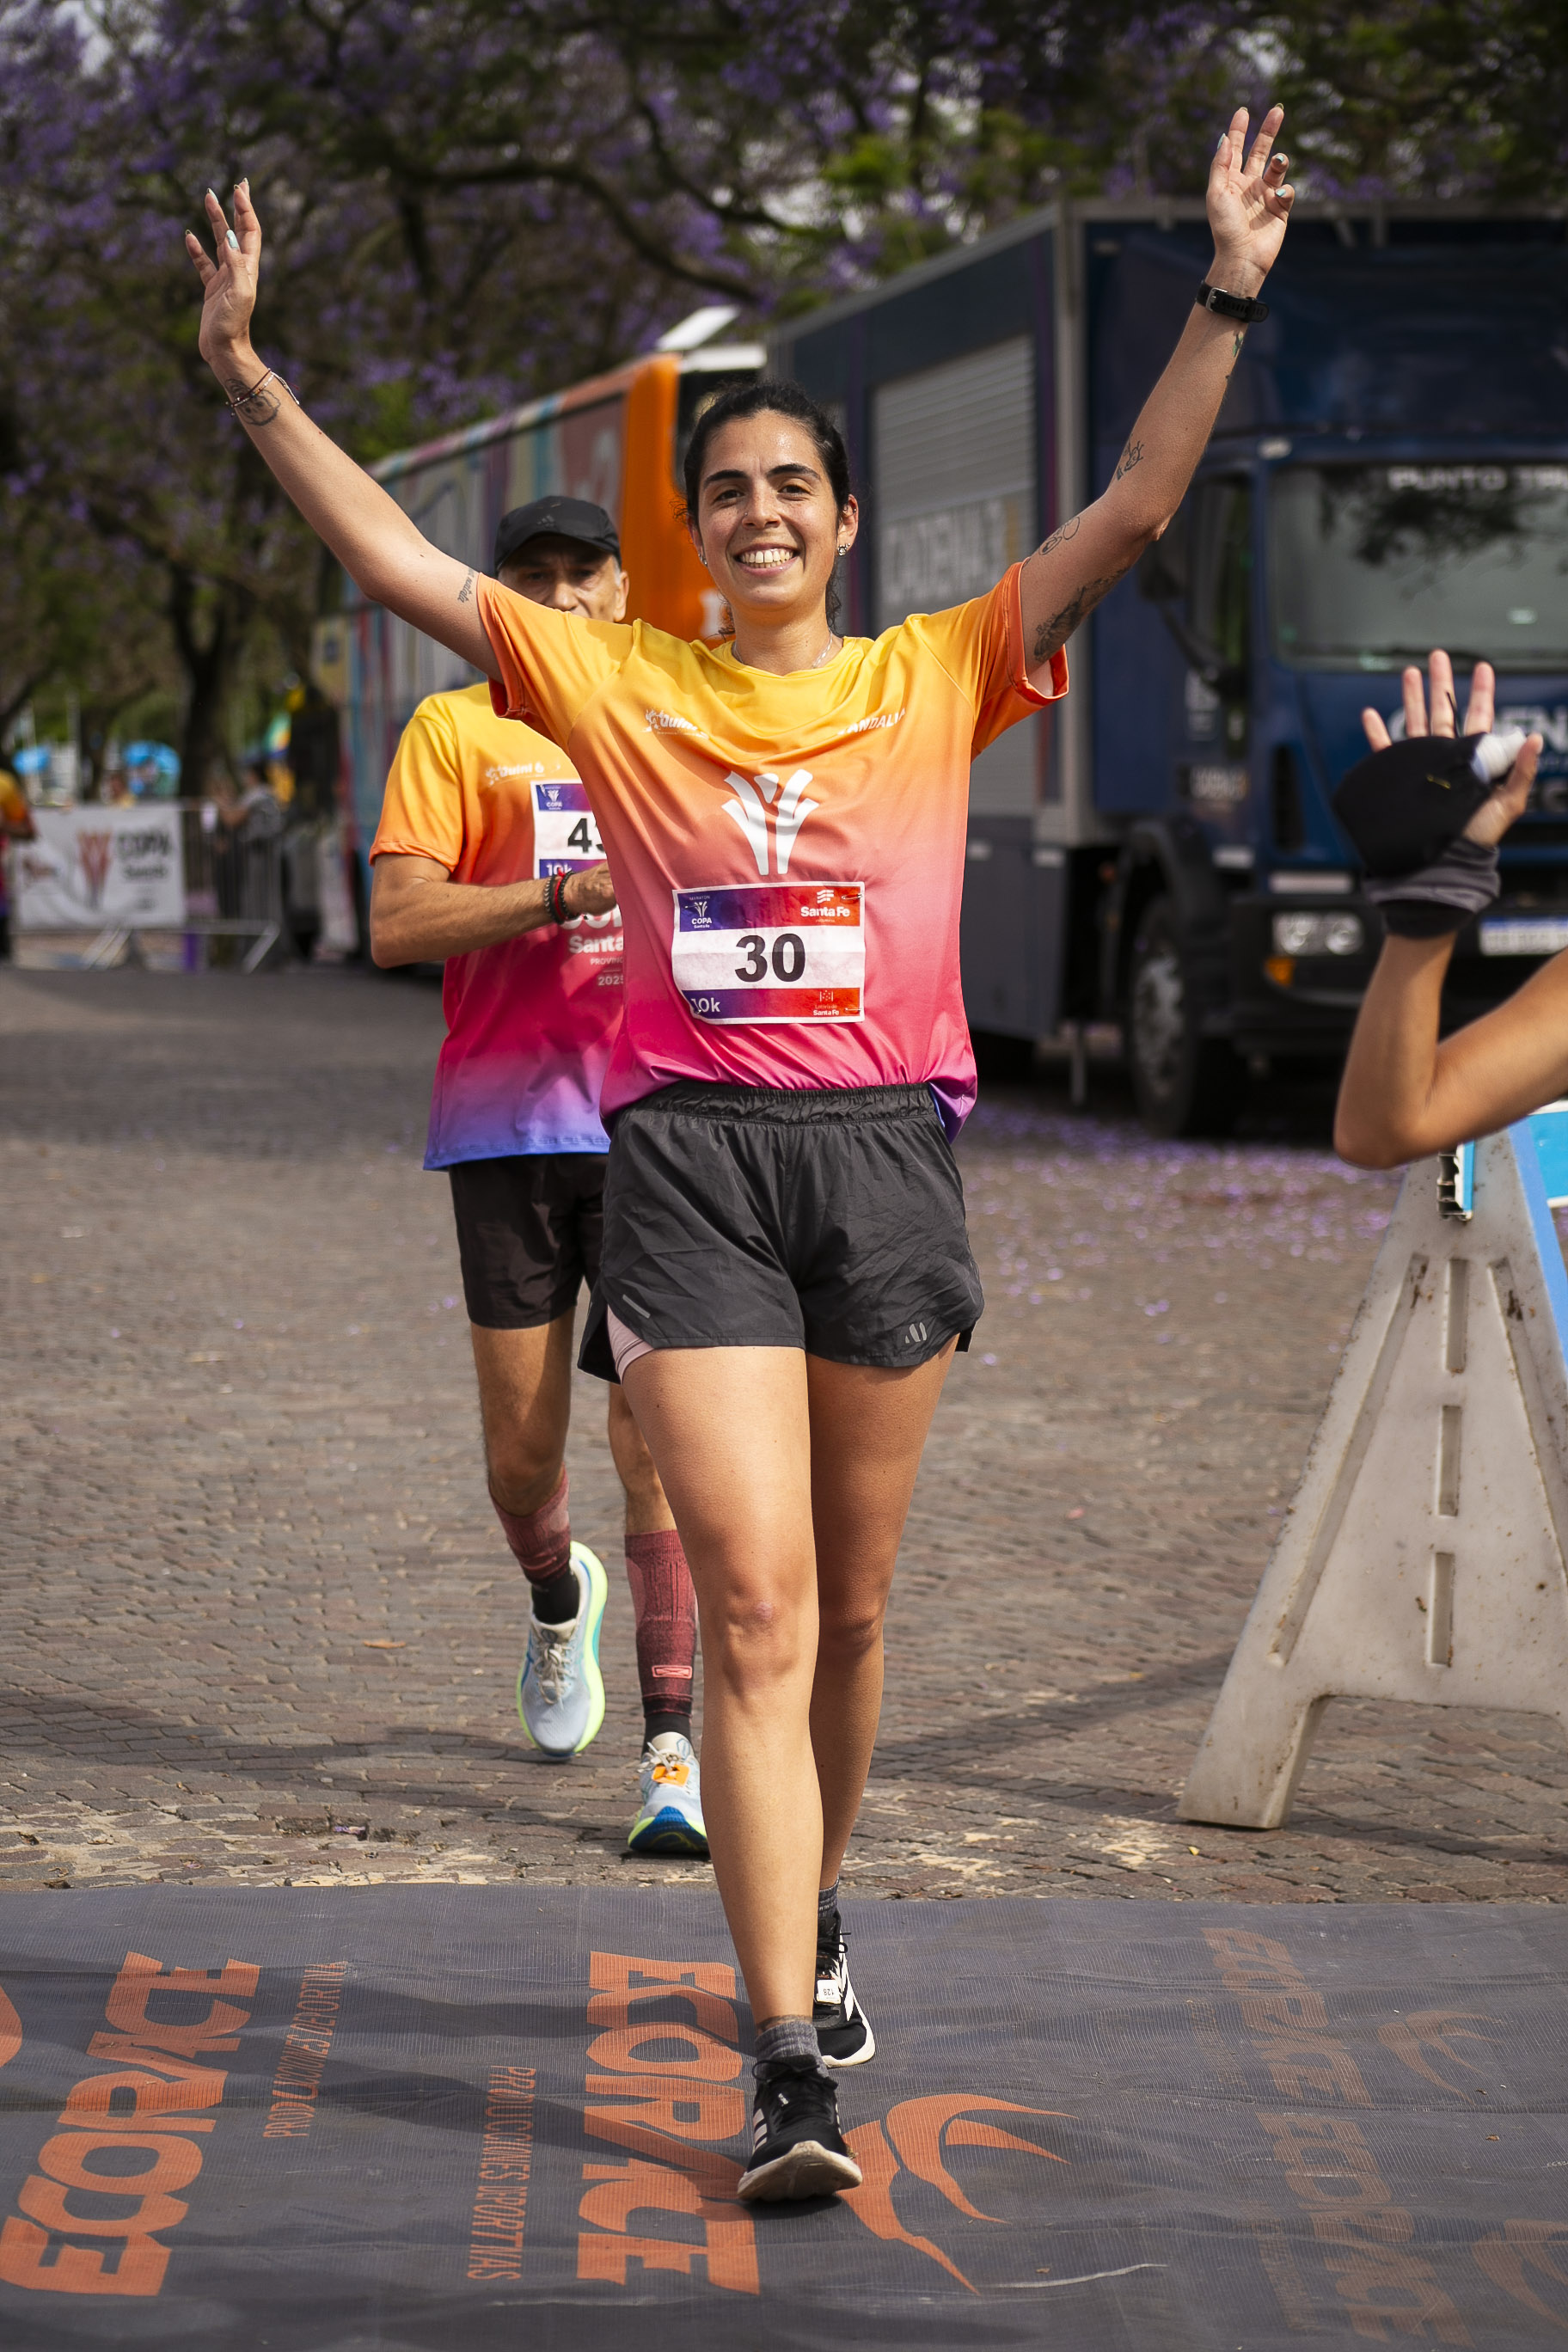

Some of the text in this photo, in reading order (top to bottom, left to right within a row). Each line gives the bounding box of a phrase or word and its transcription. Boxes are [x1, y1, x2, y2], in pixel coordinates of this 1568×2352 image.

[837, 707, 905, 735] ANDALIA
[567, 818, 605, 854] 4
[800, 905, 850, 917] Santa Fe
[735, 933, 805, 983] 30
[0, 1951, 262, 2296] ECORACE
